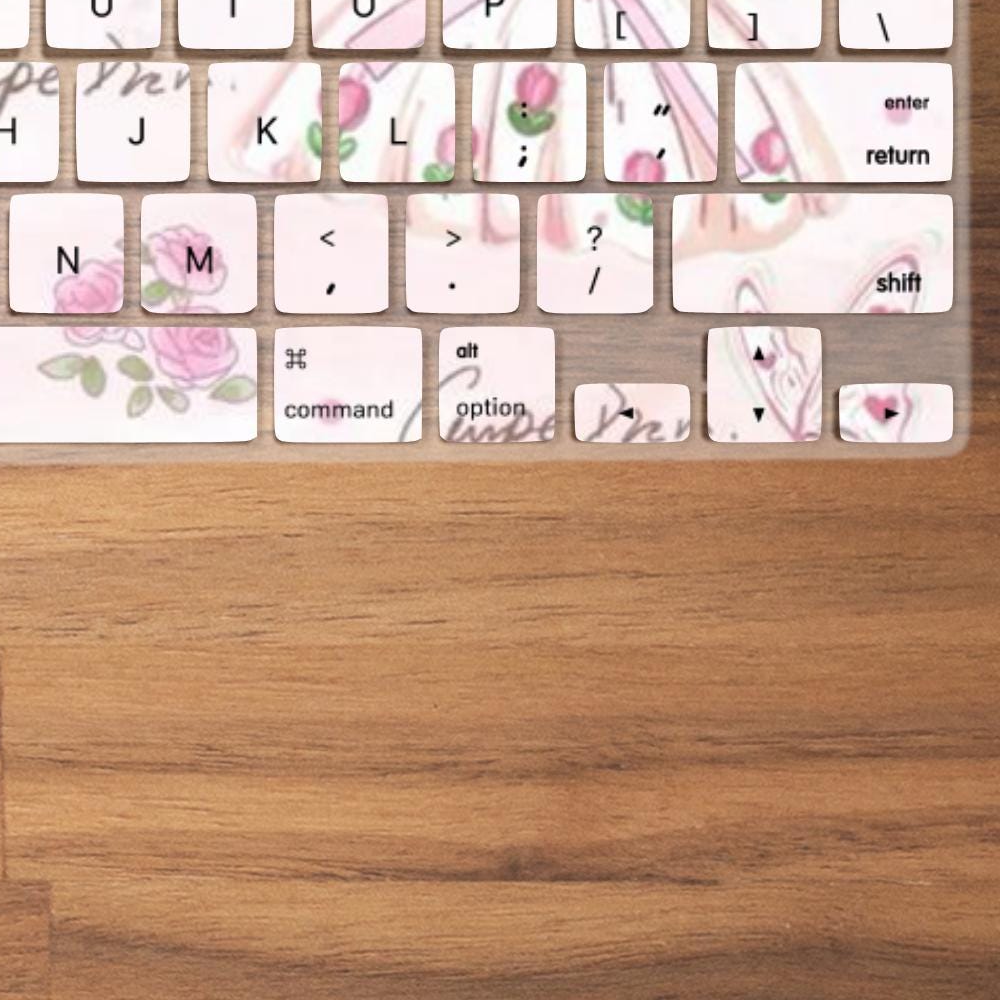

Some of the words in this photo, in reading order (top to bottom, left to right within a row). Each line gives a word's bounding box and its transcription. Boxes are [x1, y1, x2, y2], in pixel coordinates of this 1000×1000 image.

[884, 95, 930, 109] enter
[128, 117, 145, 145] J
[257, 117, 277, 145] K
[391, 117, 408, 145] L
[866, 145, 930, 165] return
[588, 225, 603, 252] ?
[57, 246, 79, 274] N
[186, 245, 213, 274] M
[876, 271, 922, 292] shift
[456, 342, 479, 358] alt
[284, 400, 394, 417] command
[456, 397, 527, 420] option
